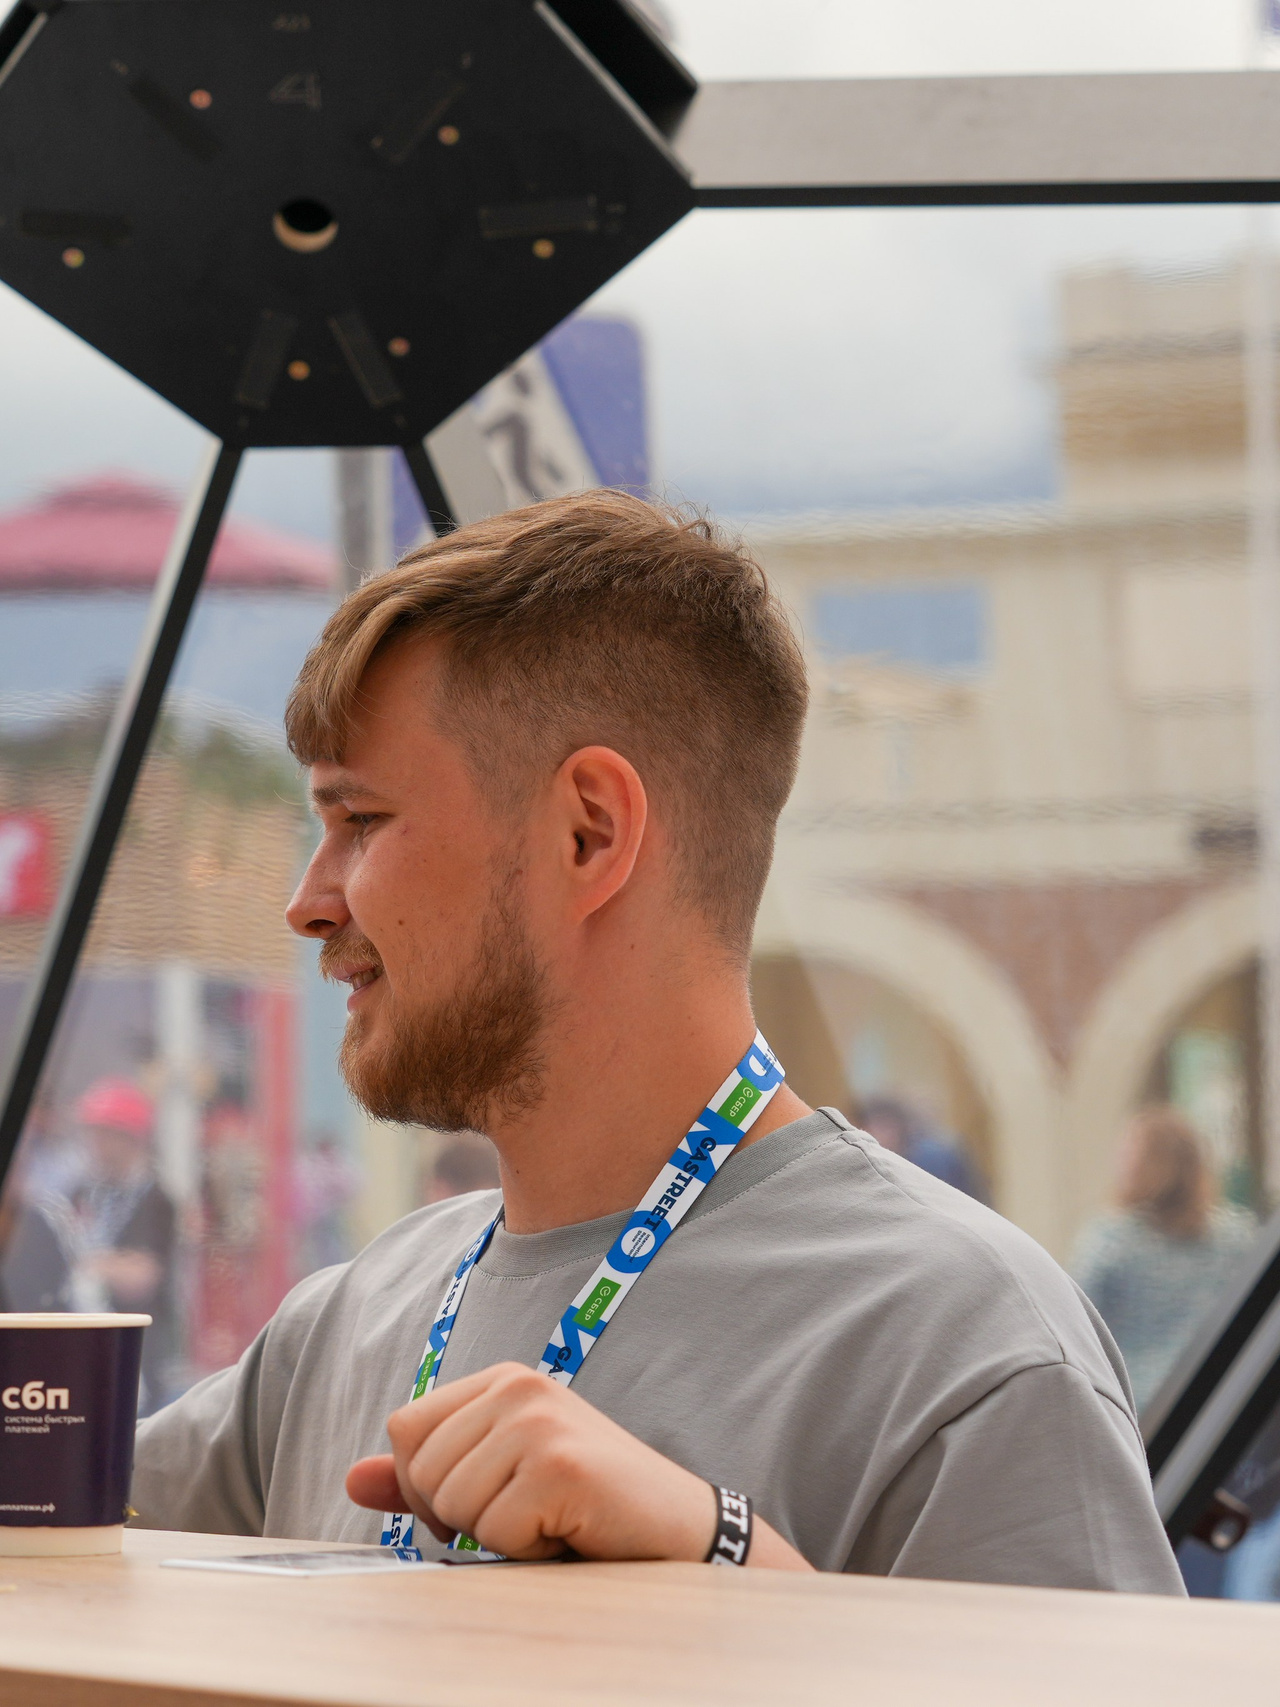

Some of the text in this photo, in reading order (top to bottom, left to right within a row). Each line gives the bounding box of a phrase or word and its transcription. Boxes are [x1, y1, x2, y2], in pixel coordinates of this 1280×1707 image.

[729, 1096, 746, 1117] СБЕР
[643, 1137, 717, 1232] GASTREET
[584, 1297, 603, 1321] СБЕР
[2, 1381, 69, 1411] сбп
[4, 1414, 86, 1425] система быстрых
[4, 1424, 50, 1434] платежей
[720, 1487, 749, 1534] EET
